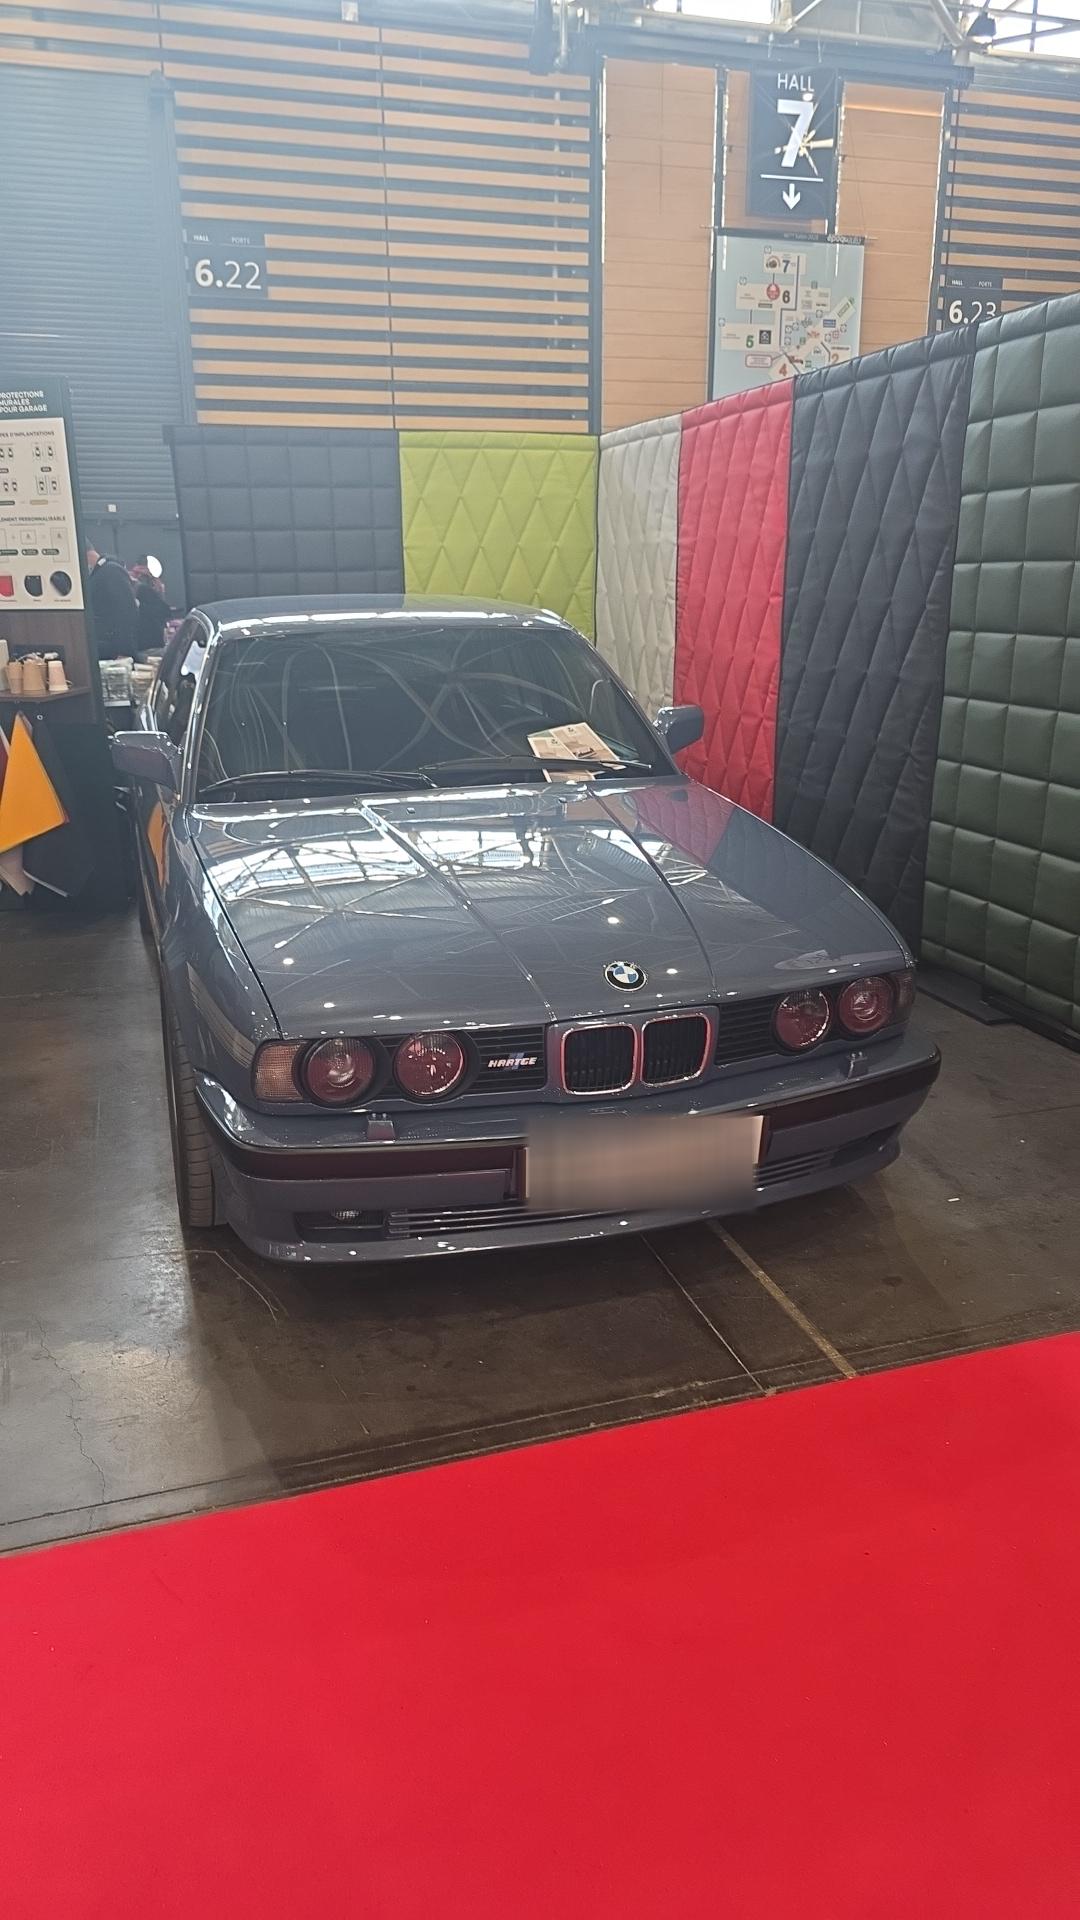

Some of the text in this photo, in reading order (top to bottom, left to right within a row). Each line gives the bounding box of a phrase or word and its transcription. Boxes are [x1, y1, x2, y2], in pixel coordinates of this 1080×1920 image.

[777, 73, 815, 92] HALL
[777, 99, 814, 168] 7
[193, 234, 209, 242] HALL
[782, 259, 791, 273] 7
[195, 259, 261, 290] 6.22
[949, 300, 997, 324] 6.23
[778, 363, 788, 377] 4
[19, 404, 48, 412] GARAGE
[487, 1056, 538, 1068] HARTGE
